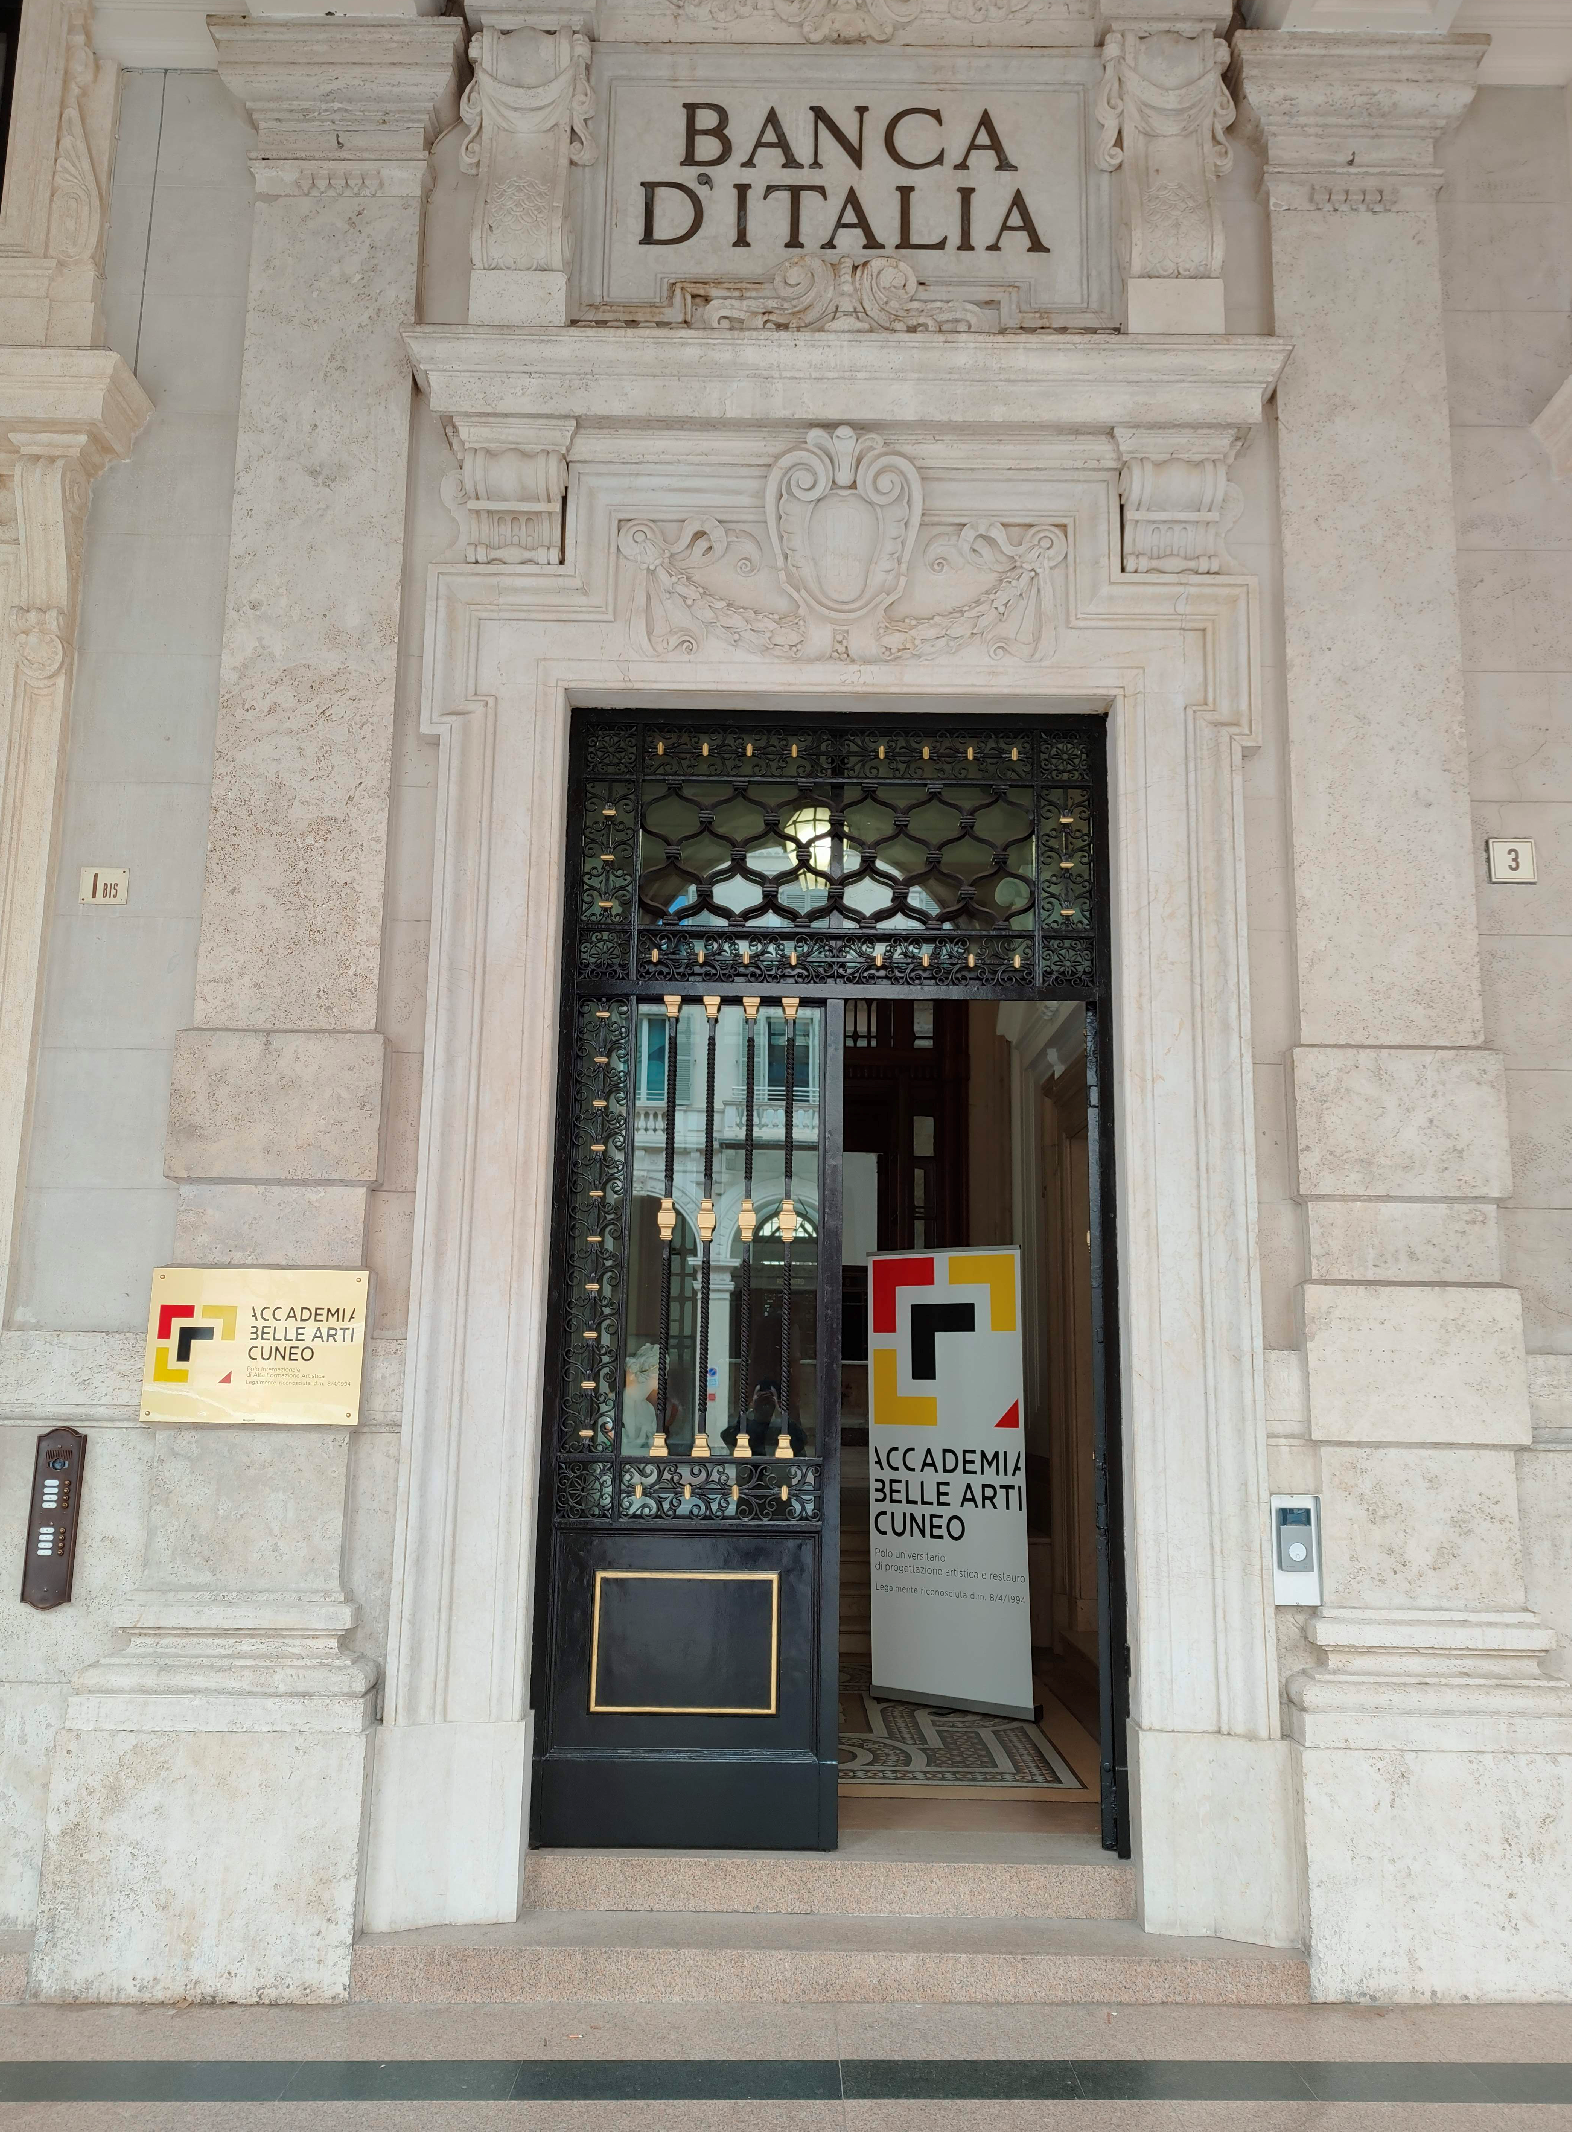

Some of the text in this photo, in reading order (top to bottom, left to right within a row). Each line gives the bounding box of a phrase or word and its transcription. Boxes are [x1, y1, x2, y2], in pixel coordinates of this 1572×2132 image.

[680, 102, 1018, 171] BANCA
[638, 173, 1050, 252] D'ITALIA
[1507, 848, 1520, 872] 3
[102, 883, 118, 898] BIS
[251, 1305, 356, 1323] ACCADEMIA
[249, 1325, 355, 1343] BELLE ARTI
[247, 1345, 315, 1362] CUNEO
[874, 1445, 1022, 1477] ACCADEMIA
[874, 1478, 1023, 1512] BELLE ARTI
[874, 1510, 965, 1541] CUNEO
[874, 1547, 946, 1563] Polo universitario
[874, 1561, 1026, 1584] di progettazione artistica e restauro
[875, 1582, 918, 1595] Legalmente
[920, 1587, 968, 1599] riconosciuta
[989, 1592, 1026, 1605] 8/4/1994
